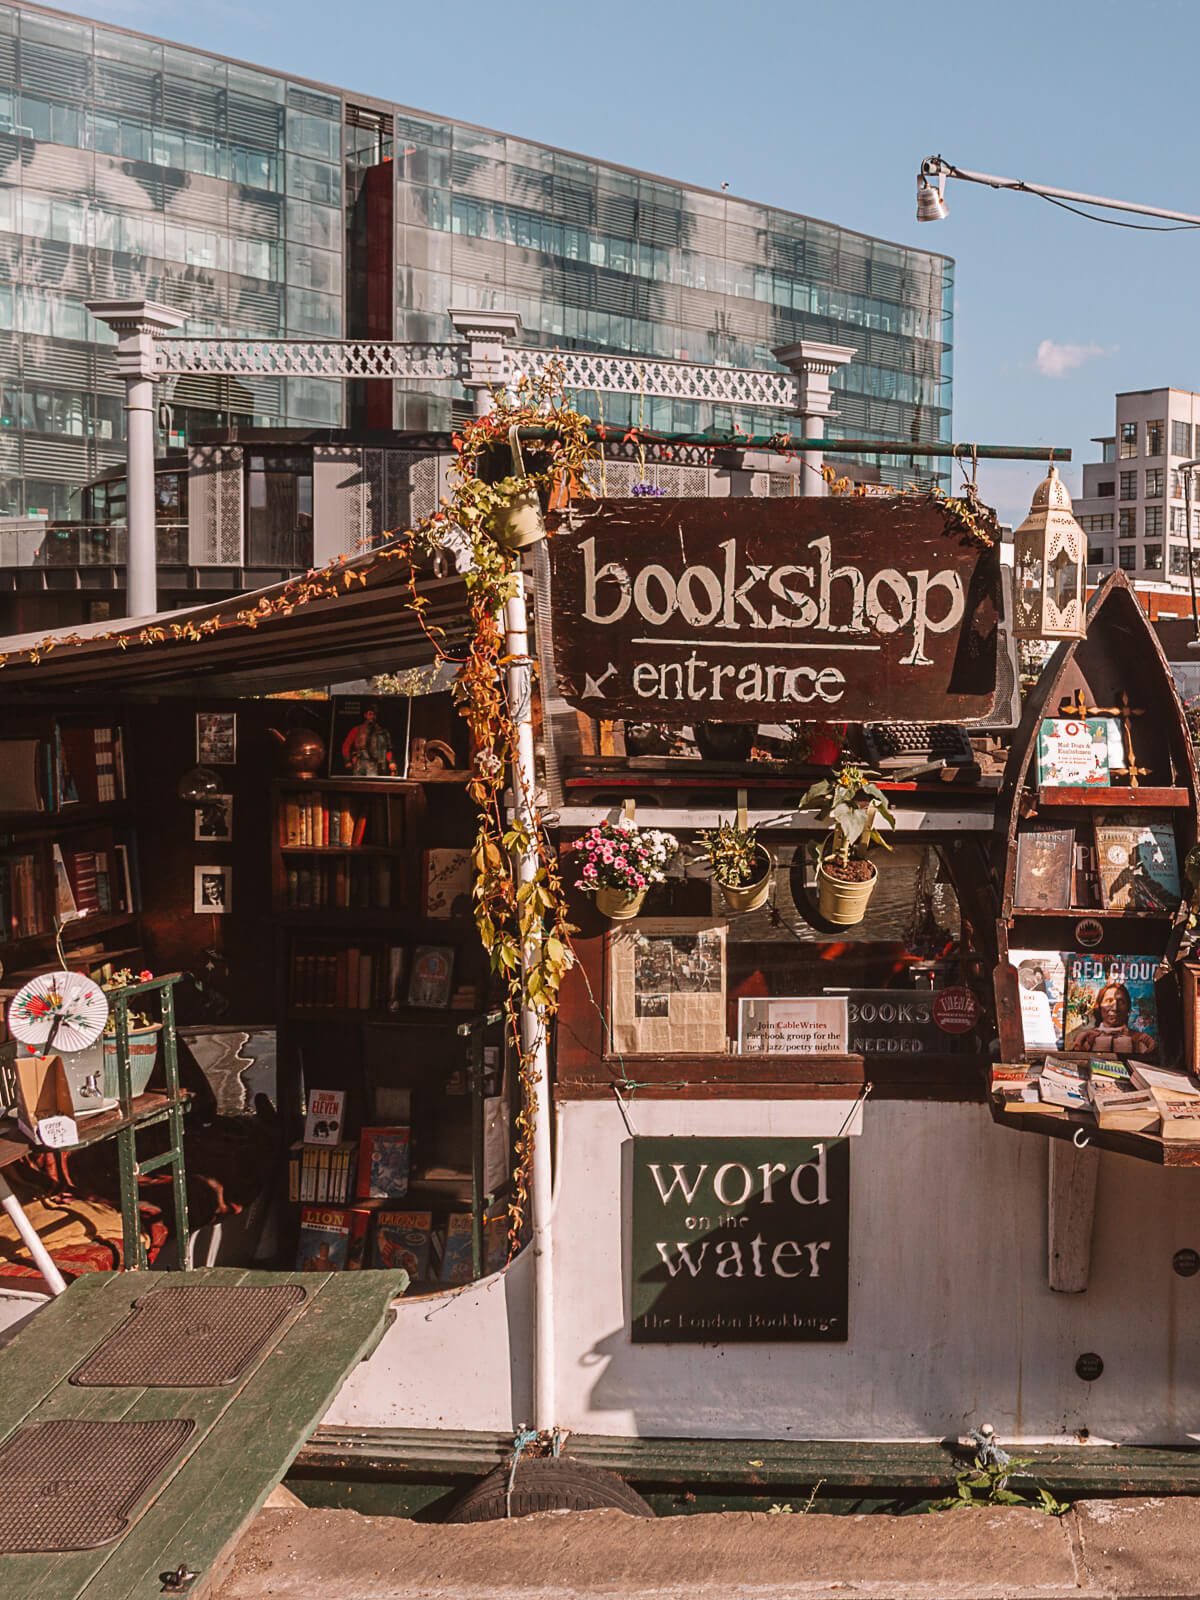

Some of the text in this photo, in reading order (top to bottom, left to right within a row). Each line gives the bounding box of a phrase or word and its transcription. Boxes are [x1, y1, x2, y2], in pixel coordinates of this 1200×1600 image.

[577, 536, 965, 665] bookshop
[632, 650, 846, 704] entrance
[1072, 961, 1103, 978] RED
[848, 1002, 931, 1024] BOOKS
[758, 1021, 827, 1030] Join CableWrites
[746, 1032, 841, 1041] Facebook group for the
[815, 1043, 840, 1053] nights
[853, 1038, 922, 1053] NEEDED
[312, 1101, 339, 1115] ELEVEN
[647, 1143, 831, 1206] word
[306, 1210, 345, 1226] LION
[684, 1211, 750, 1230] on the
[655, 1232, 832, 1278] water
[643, 1314, 671, 1329] The
[679, 1313, 743, 1329] London
